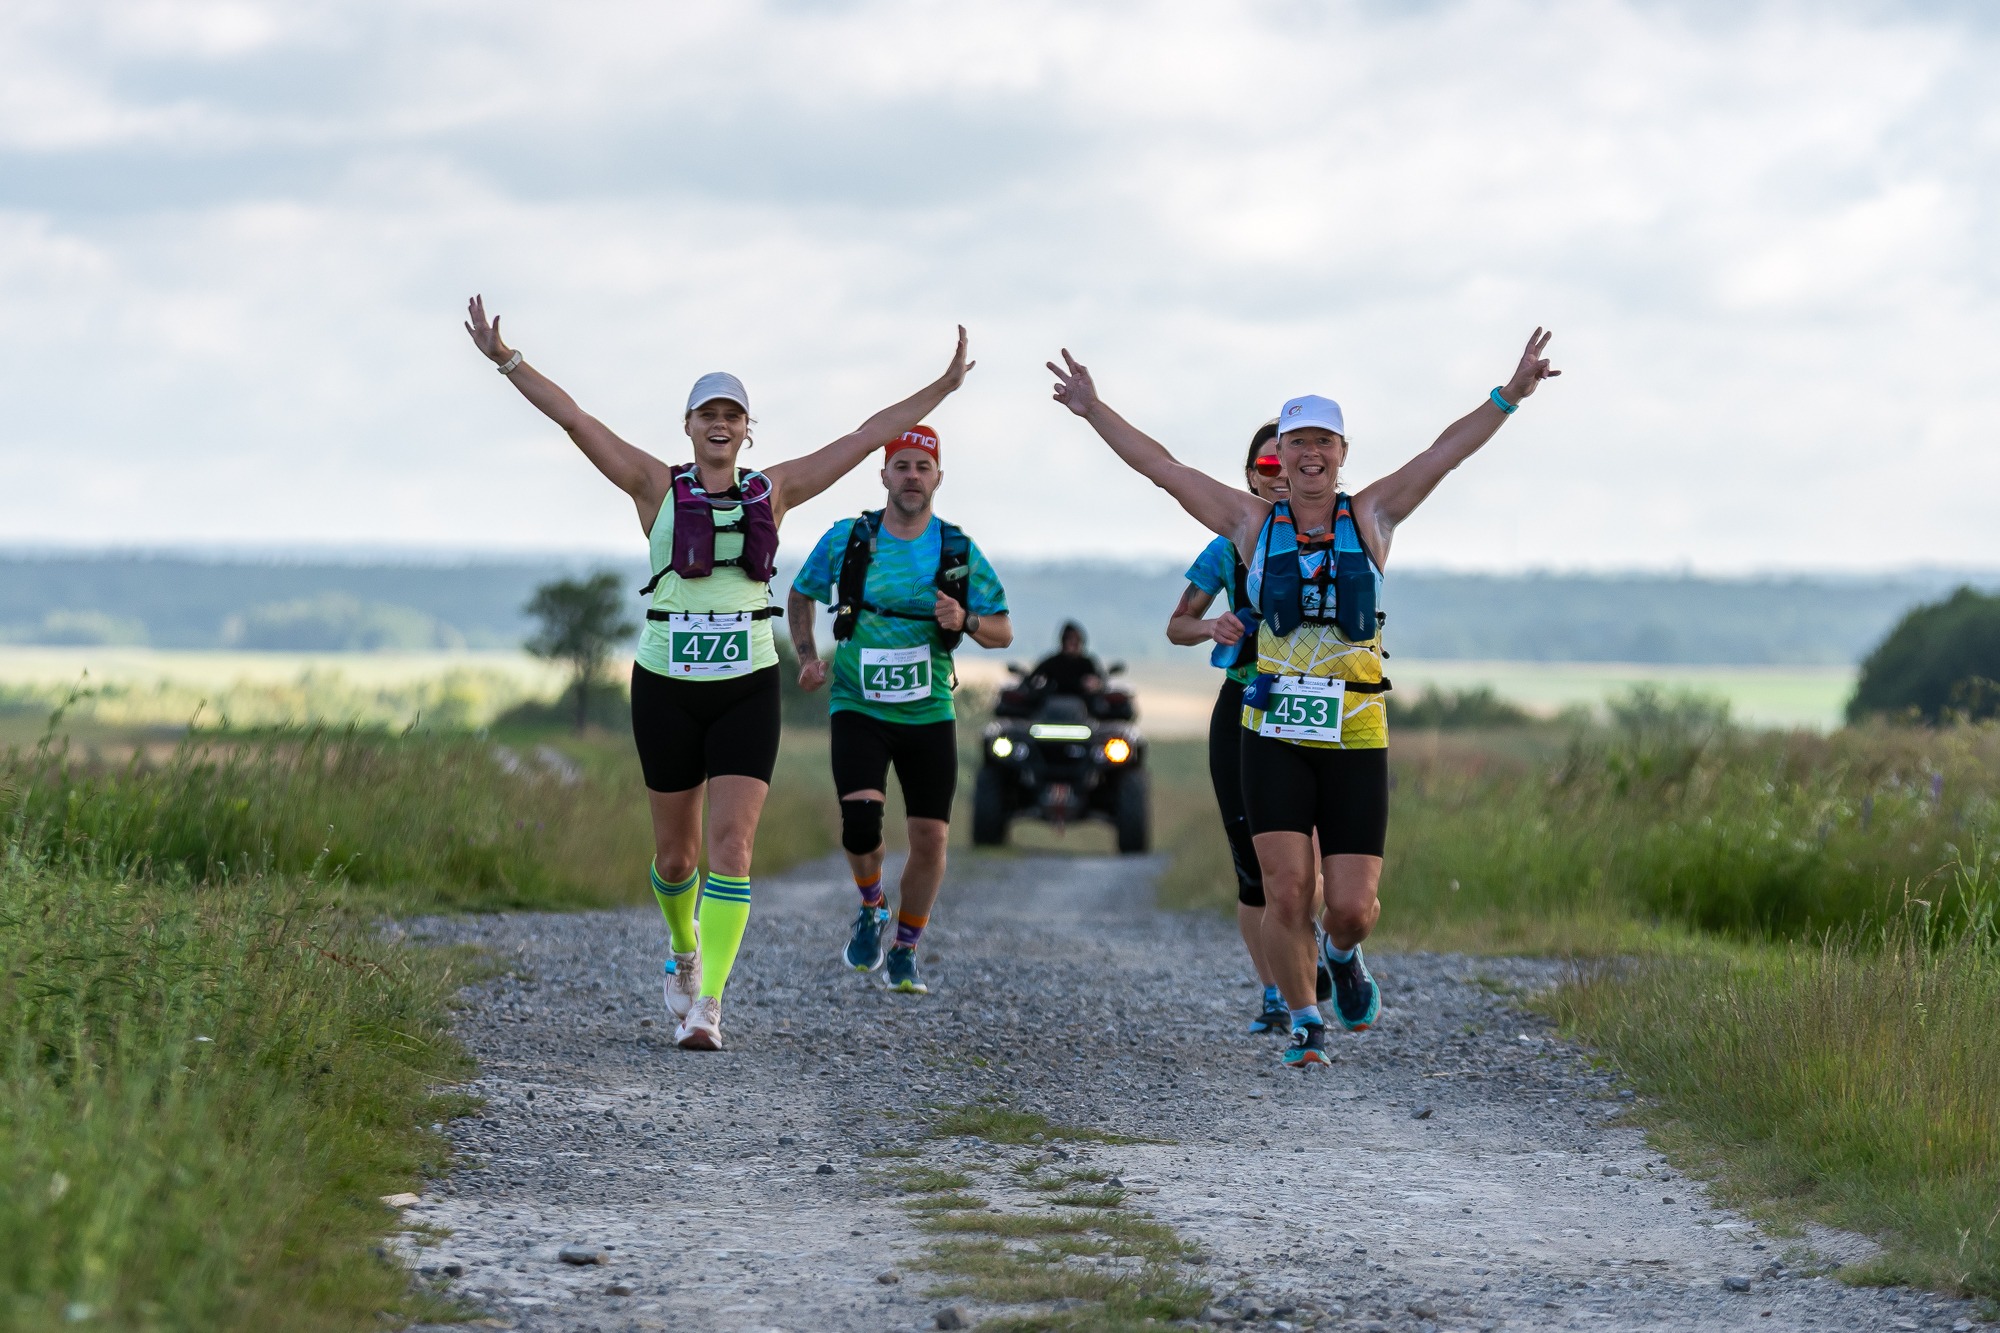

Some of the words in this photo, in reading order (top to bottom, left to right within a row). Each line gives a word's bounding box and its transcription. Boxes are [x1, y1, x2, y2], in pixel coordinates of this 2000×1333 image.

[897, 431, 937, 450] TTIQ
[681, 634, 740, 661] 476
[872, 664, 922, 690] 451
[1274, 697, 1329, 726] 453
